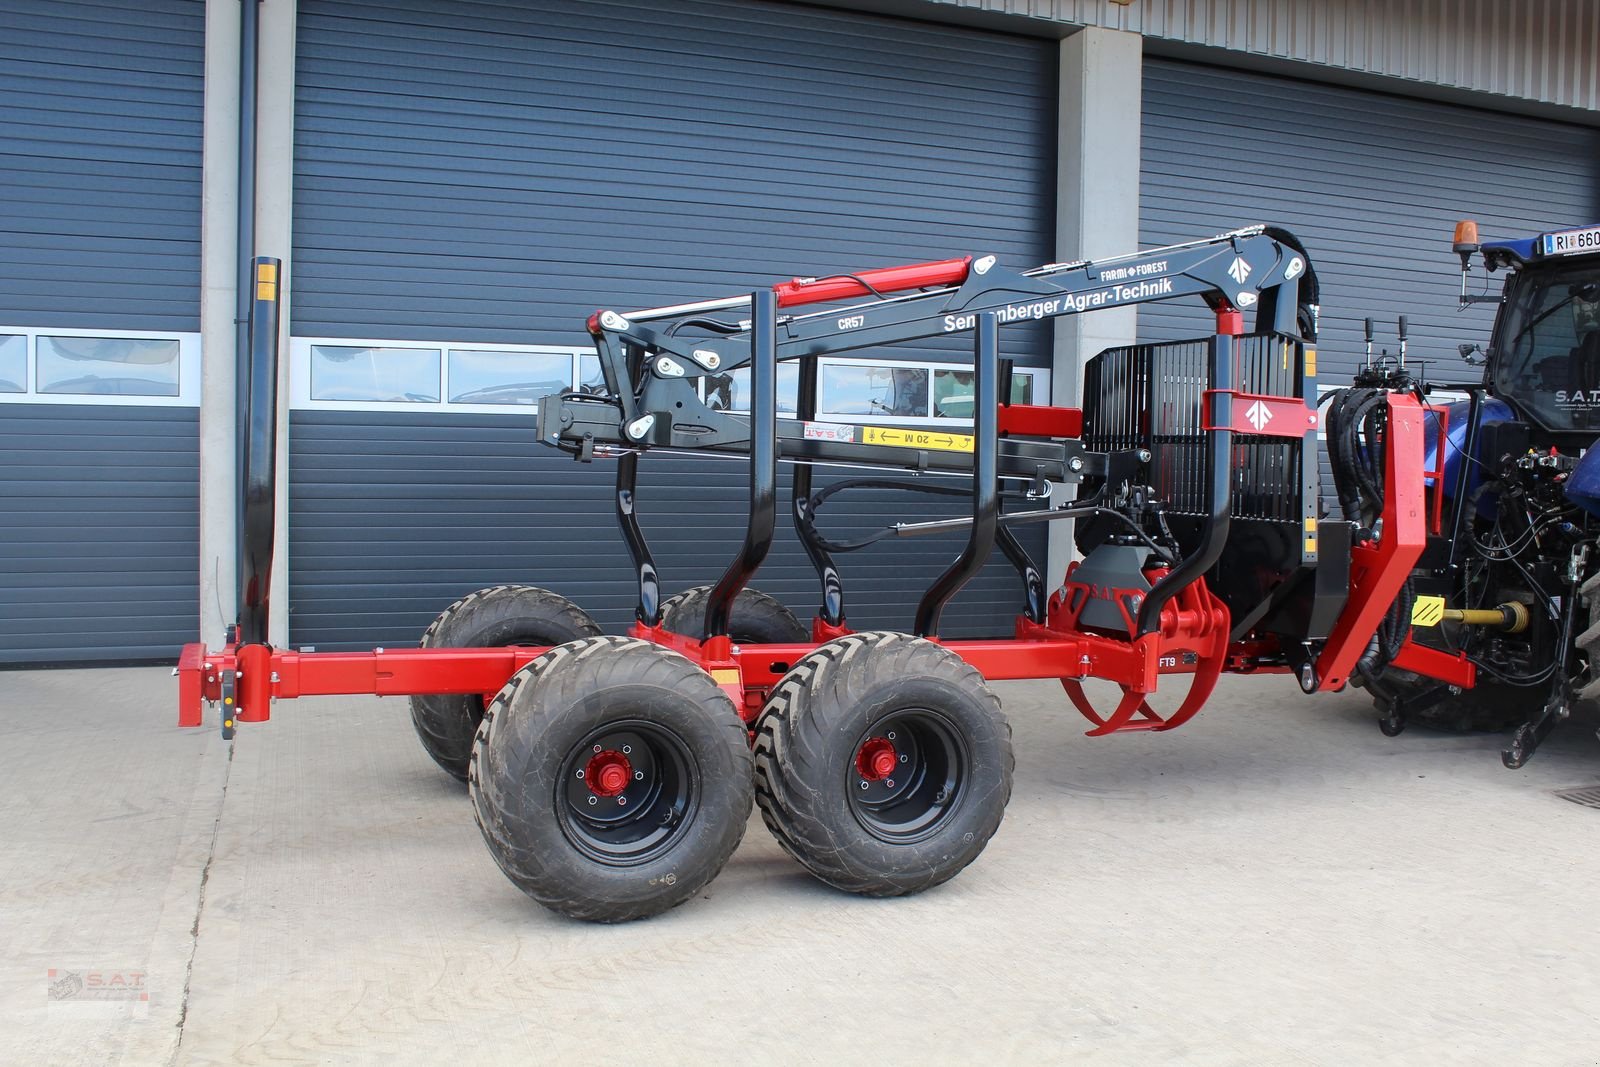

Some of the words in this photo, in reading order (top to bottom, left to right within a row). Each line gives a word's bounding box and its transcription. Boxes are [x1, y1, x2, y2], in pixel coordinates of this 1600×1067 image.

[1556, 236, 1568, 250] RI
[1578, 231, 1600, 248] 660
[1100, 269, 1128, 282] FARMI
[1136, 261, 1168, 276] FOREST
[943, 299, 1061, 332] Sennberger
[1063, 278, 1173, 312] Agrar-Technik
[838, 315, 864, 330] CR57
[904, 434, 913, 443] M
[916, 435, 929, 444] 20
[1159, 657, 1176, 668] FT9
